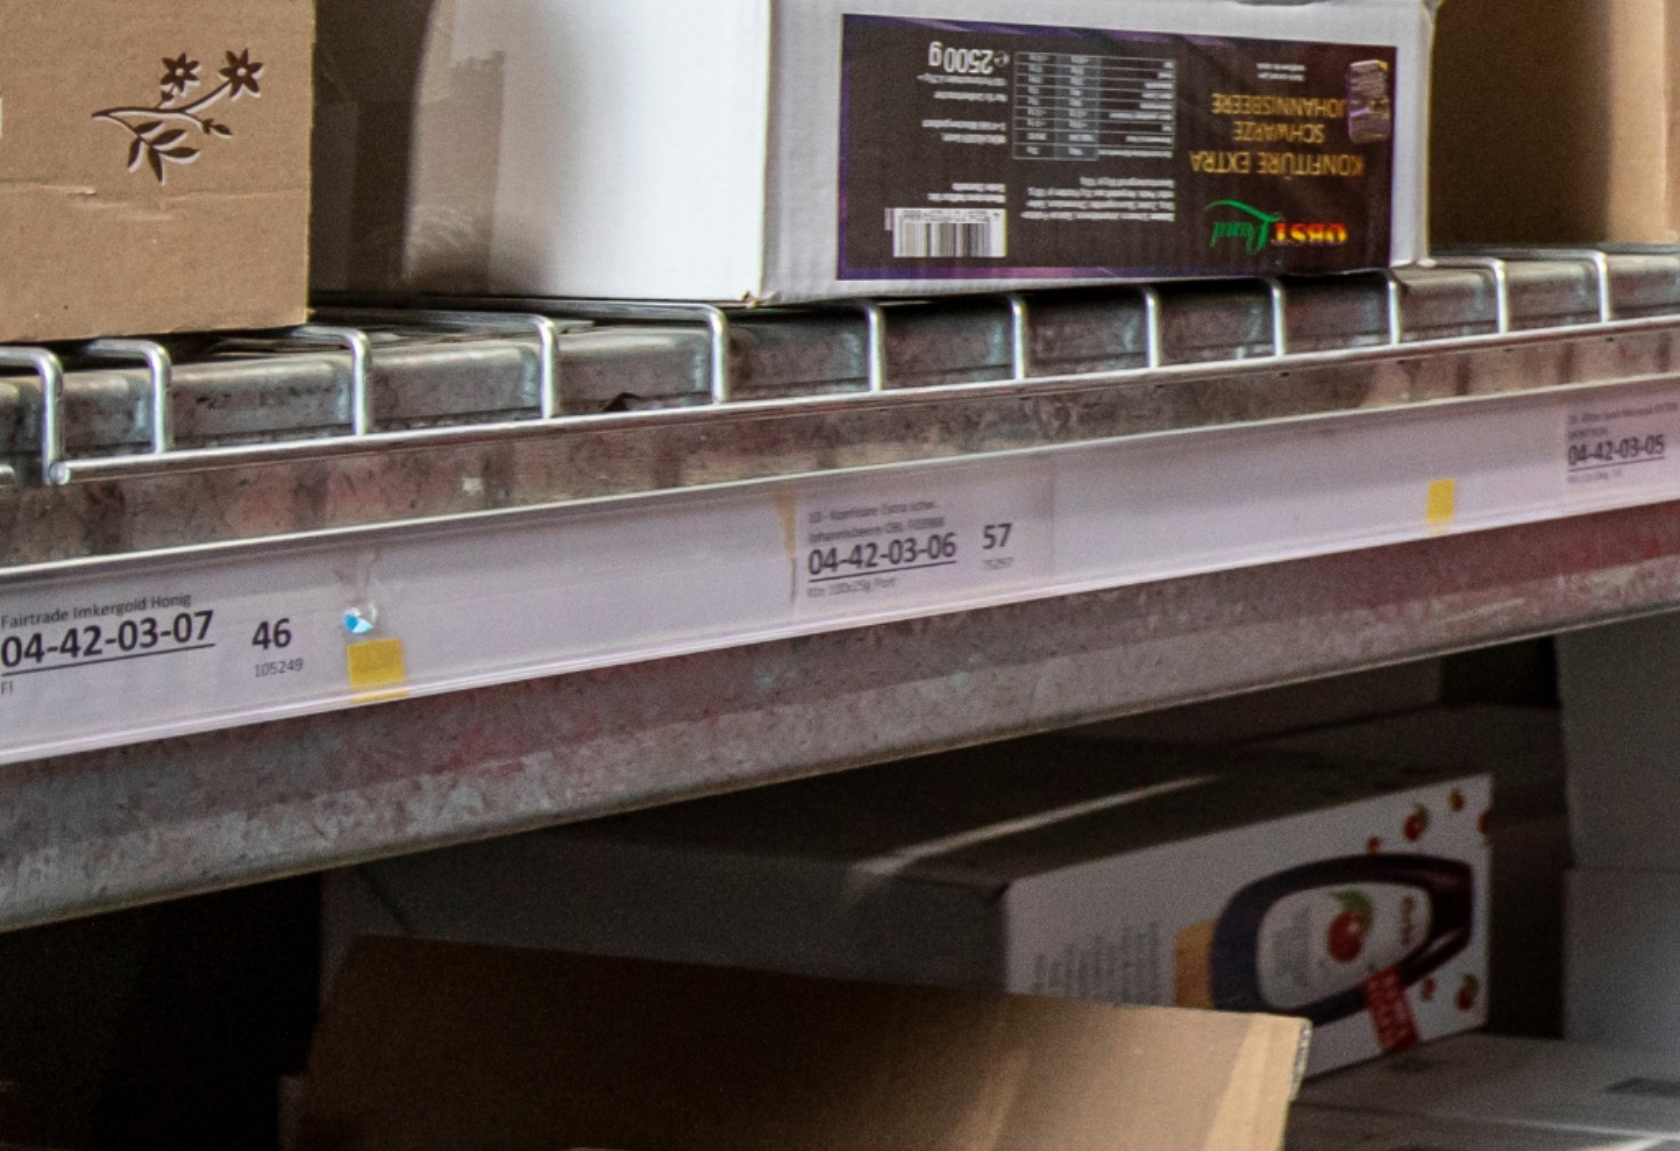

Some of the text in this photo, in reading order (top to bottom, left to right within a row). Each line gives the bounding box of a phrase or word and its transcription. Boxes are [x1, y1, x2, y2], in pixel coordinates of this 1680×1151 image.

[1211, 93, 1346, 118] JOHANNISBEERE
[1233, 121, 1325, 144] SCHWARZE
[1189, 151, 1365, 181] KONFITÜRE EXTRA
[1270, 222, 1348, 246] OBST
[1568, 434, 1664, 466] 04-42-03-05
[808, 532, 957, 575] 04-42-03-06
[983, 523, 1013, 549] 57
[1, 609, 68, 630] Fairtrade
[151, 594, 192, 609] Honig
[1, 610, 292, 667] 04-42-03-07 46
